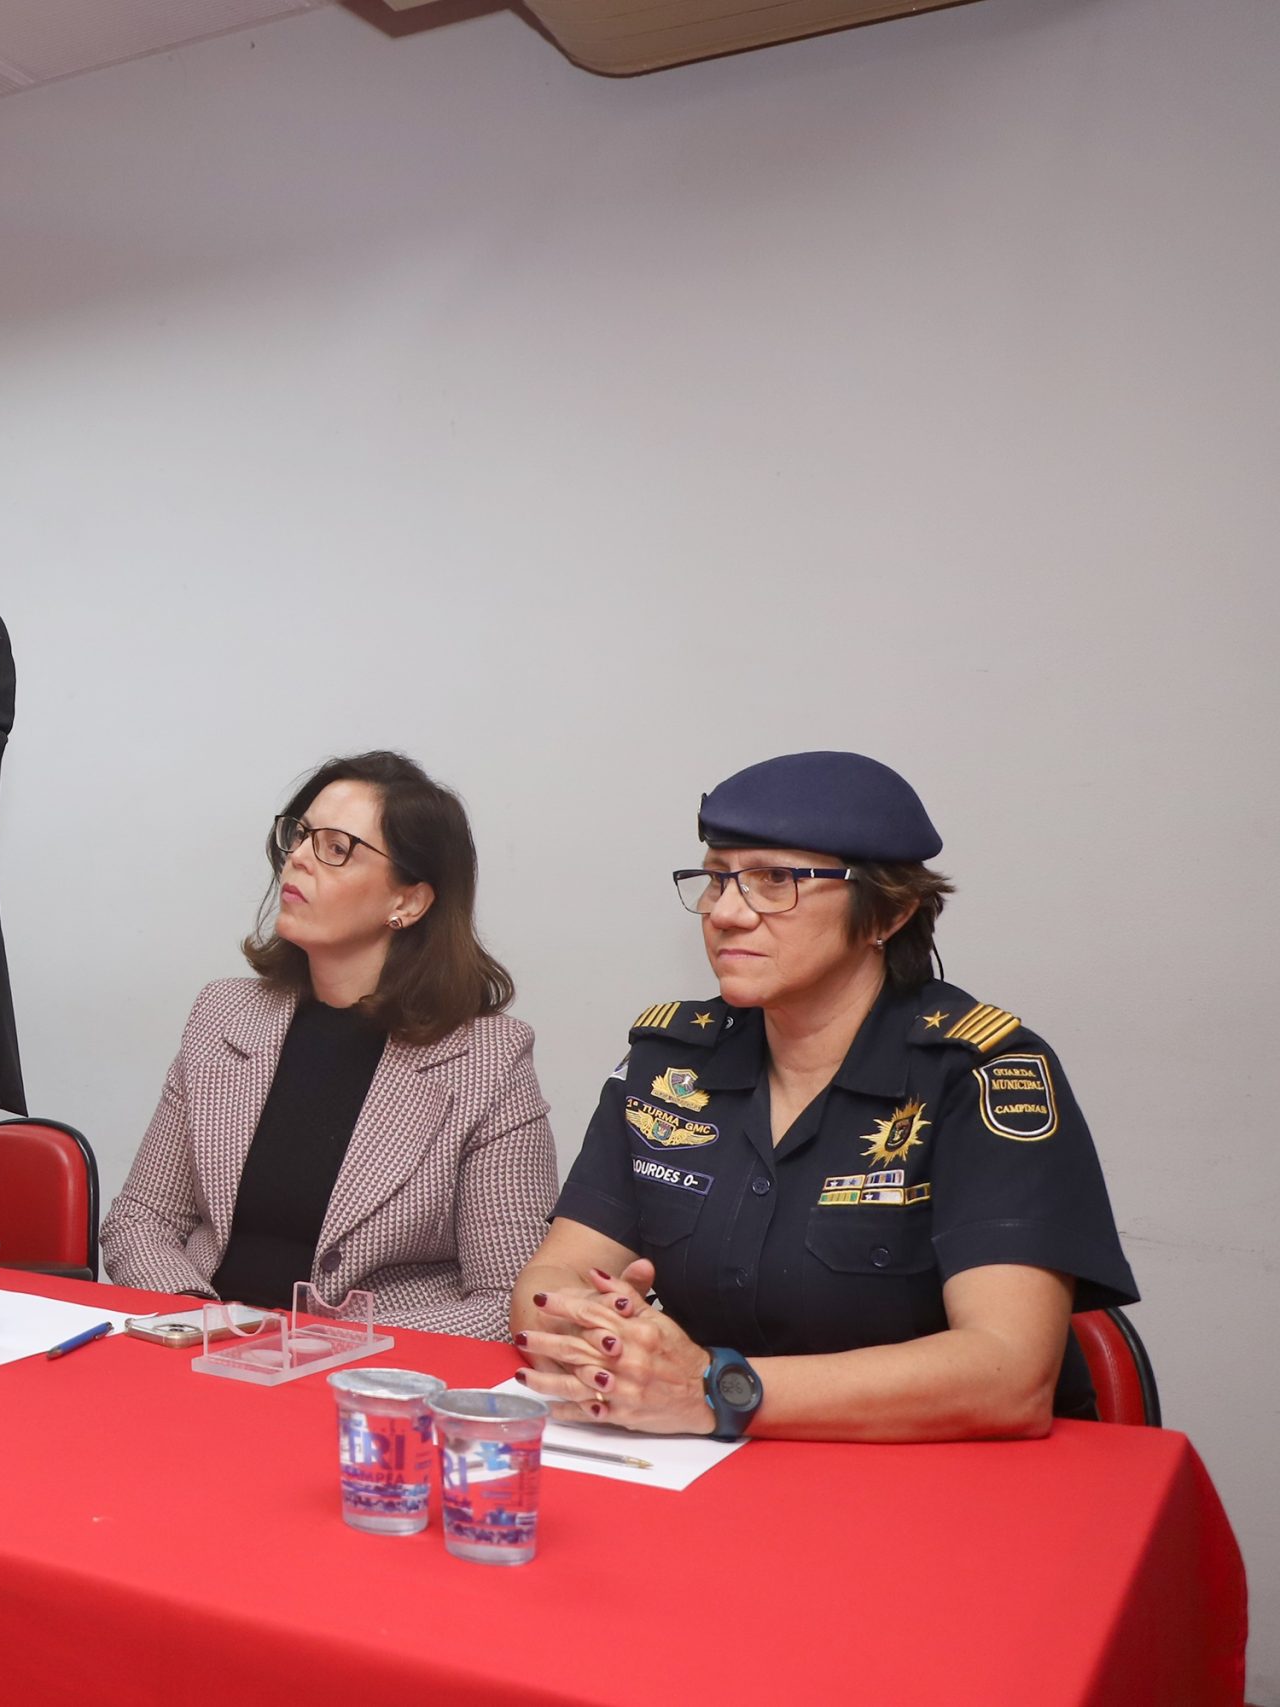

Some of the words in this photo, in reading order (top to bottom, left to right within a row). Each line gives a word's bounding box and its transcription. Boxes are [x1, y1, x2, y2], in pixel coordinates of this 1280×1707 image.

[992, 1068, 1037, 1078] GUARDA
[991, 1079, 1045, 1090] MUNICIPAL
[994, 1103, 1048, 1114] CAMPINAS
[642, 1103, 680, 1127] TURMA
[685, 1122, 711, 1134] GMC
